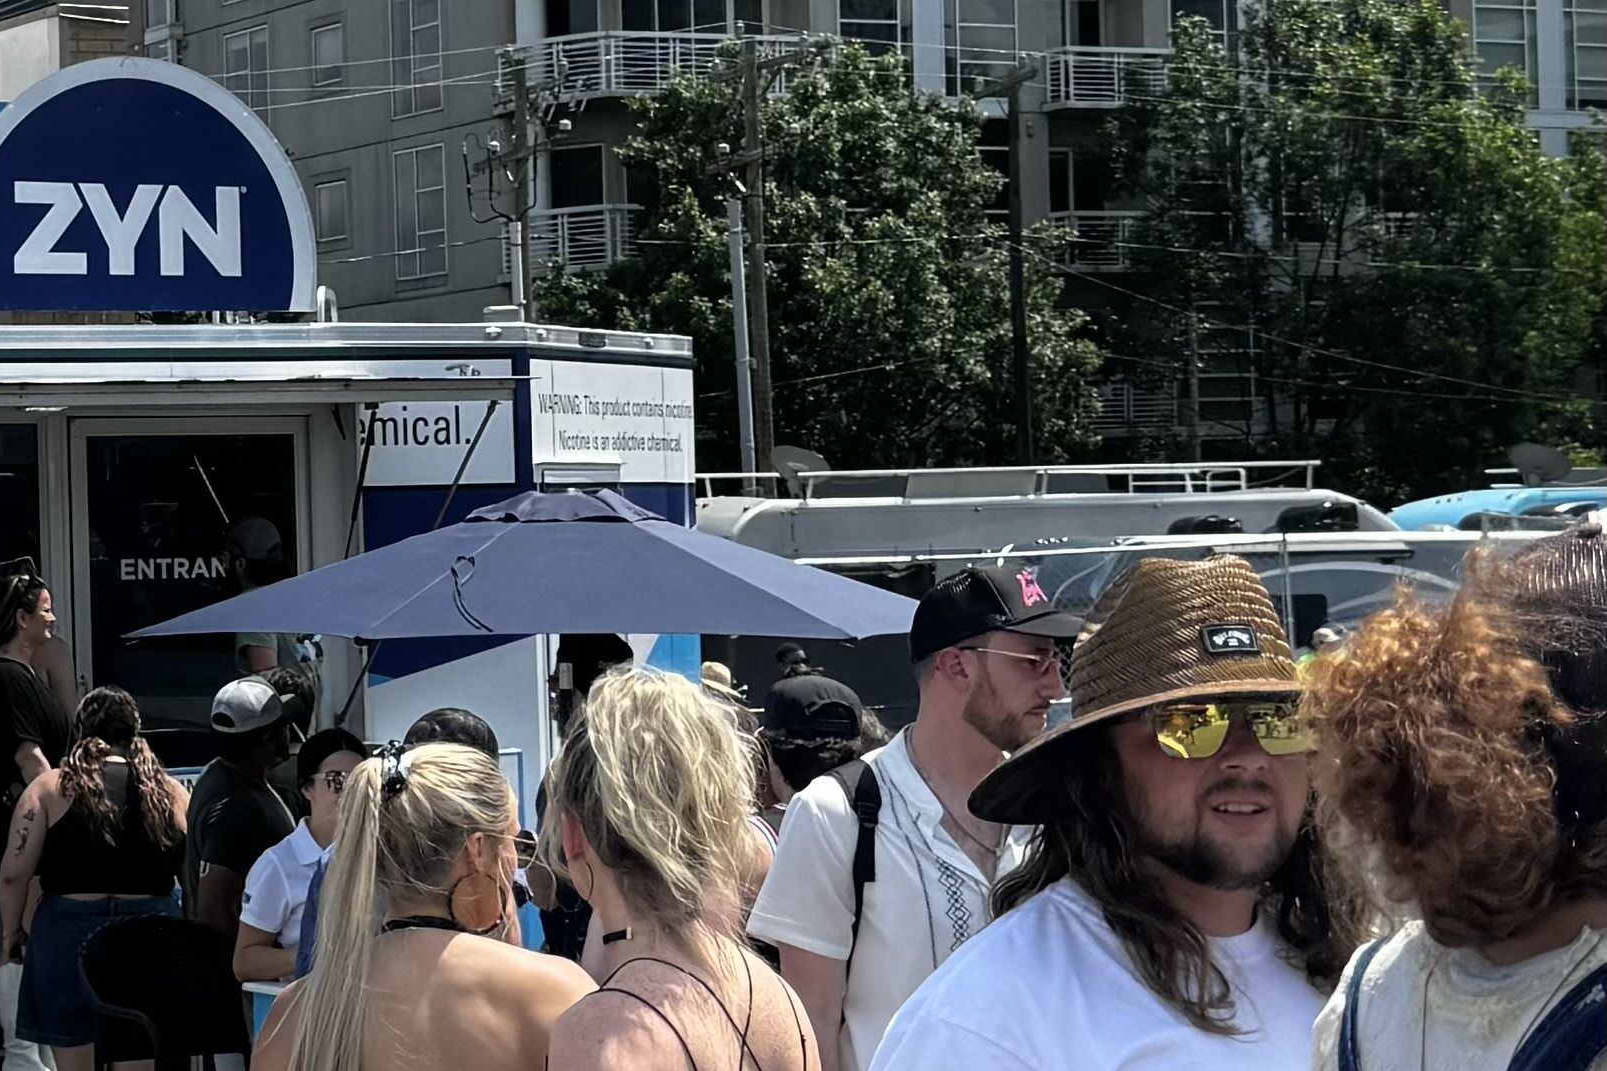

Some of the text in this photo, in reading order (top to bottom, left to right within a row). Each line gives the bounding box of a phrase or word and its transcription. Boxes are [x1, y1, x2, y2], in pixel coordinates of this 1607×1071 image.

[13, 180, 242, 277] ZYN
[538, 393, 582, 415] WARNING:
[584, 395, 600, 416] This
[602, 397, 630, 420] product
[631, 398, 664, 419] contains
[360, 404, 472, 447] mical.
[559, 430, 683, 453] Nicotine is an addictive chemical.
[120, 556, 226, 580] ENTRAN
